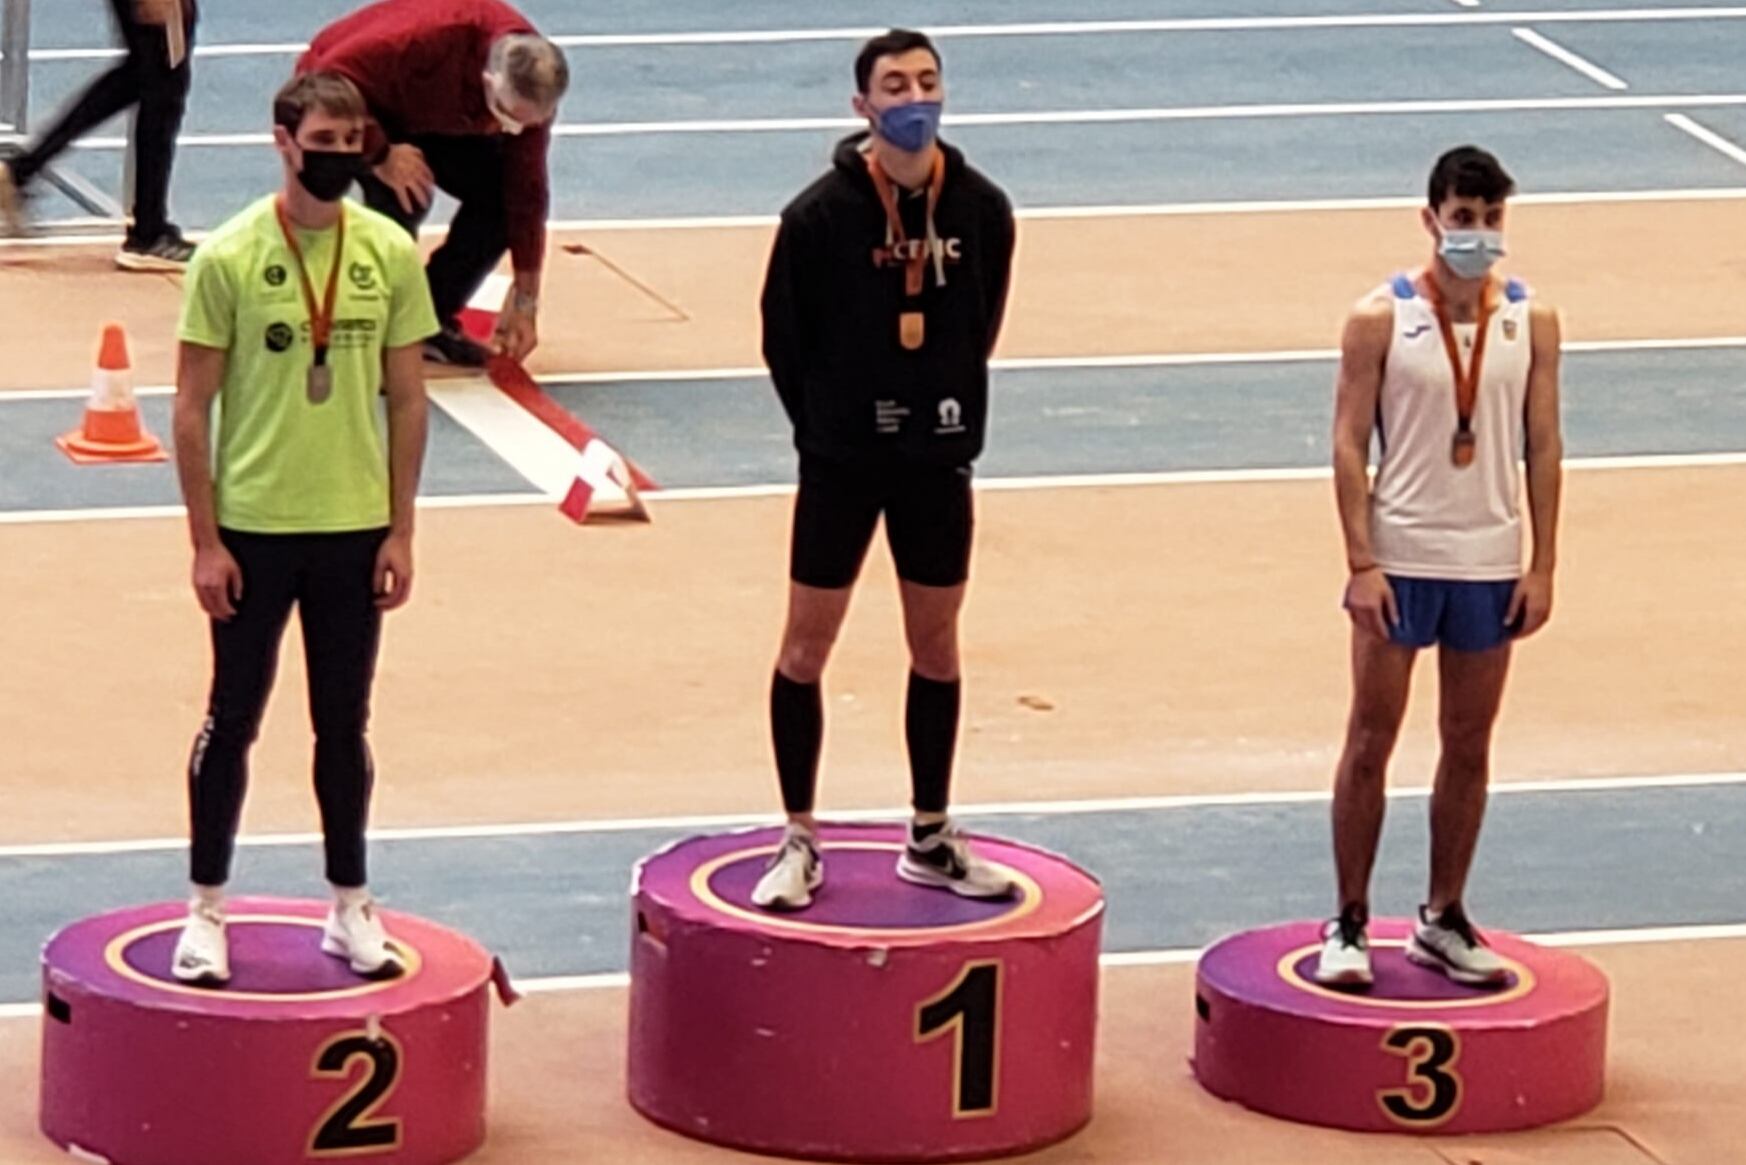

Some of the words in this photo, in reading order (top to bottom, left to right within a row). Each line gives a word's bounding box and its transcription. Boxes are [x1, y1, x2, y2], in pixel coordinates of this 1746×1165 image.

[308, 1029, 403, 1156] 2
[914, 958, 1003, 1118] 1
[1377, 1023, 1463, 1126] 3
